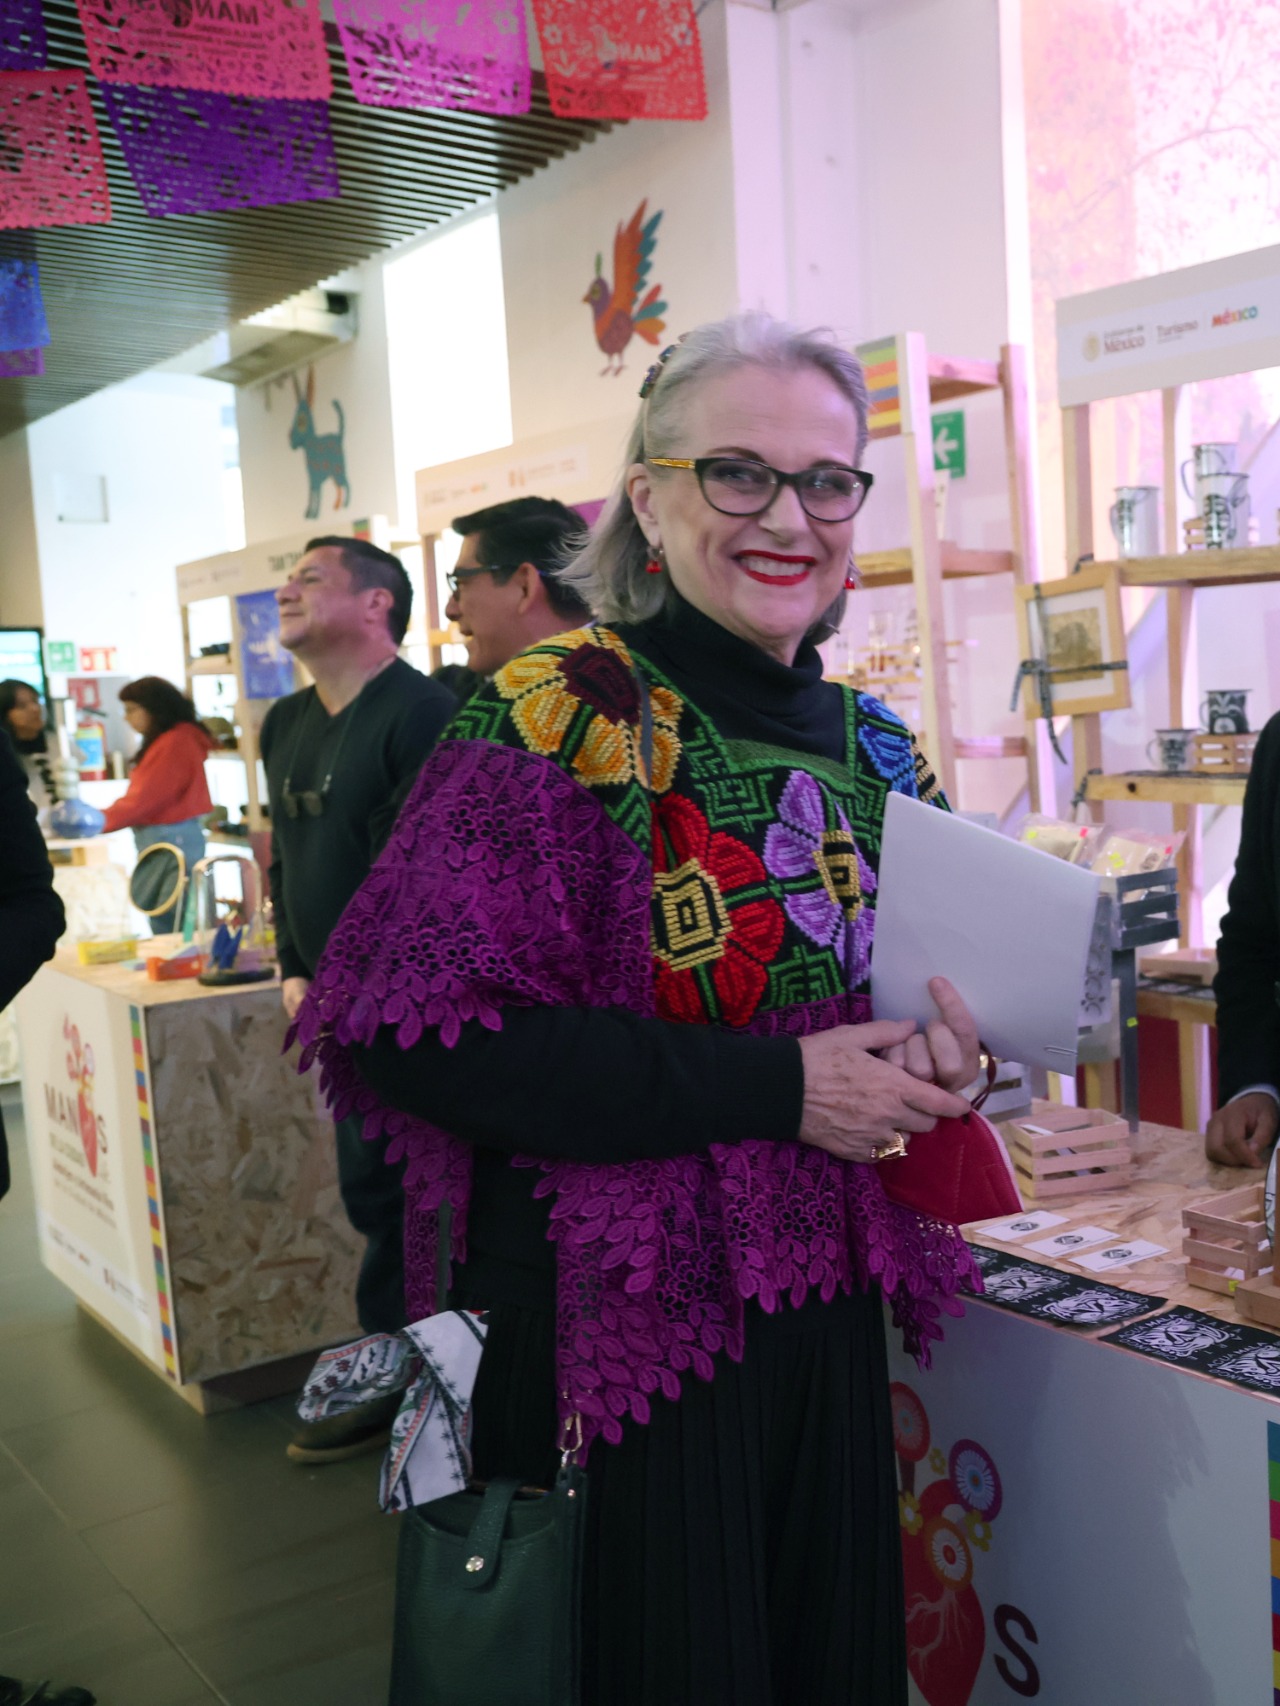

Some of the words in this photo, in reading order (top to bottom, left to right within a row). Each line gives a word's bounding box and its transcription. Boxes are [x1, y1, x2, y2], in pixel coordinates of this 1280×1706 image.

[1156, 320, 1198, 336] Turismo
[1118, 1325, 1147, 1339] AGUA
[1145, 1313, 1178, 1328] MALA
